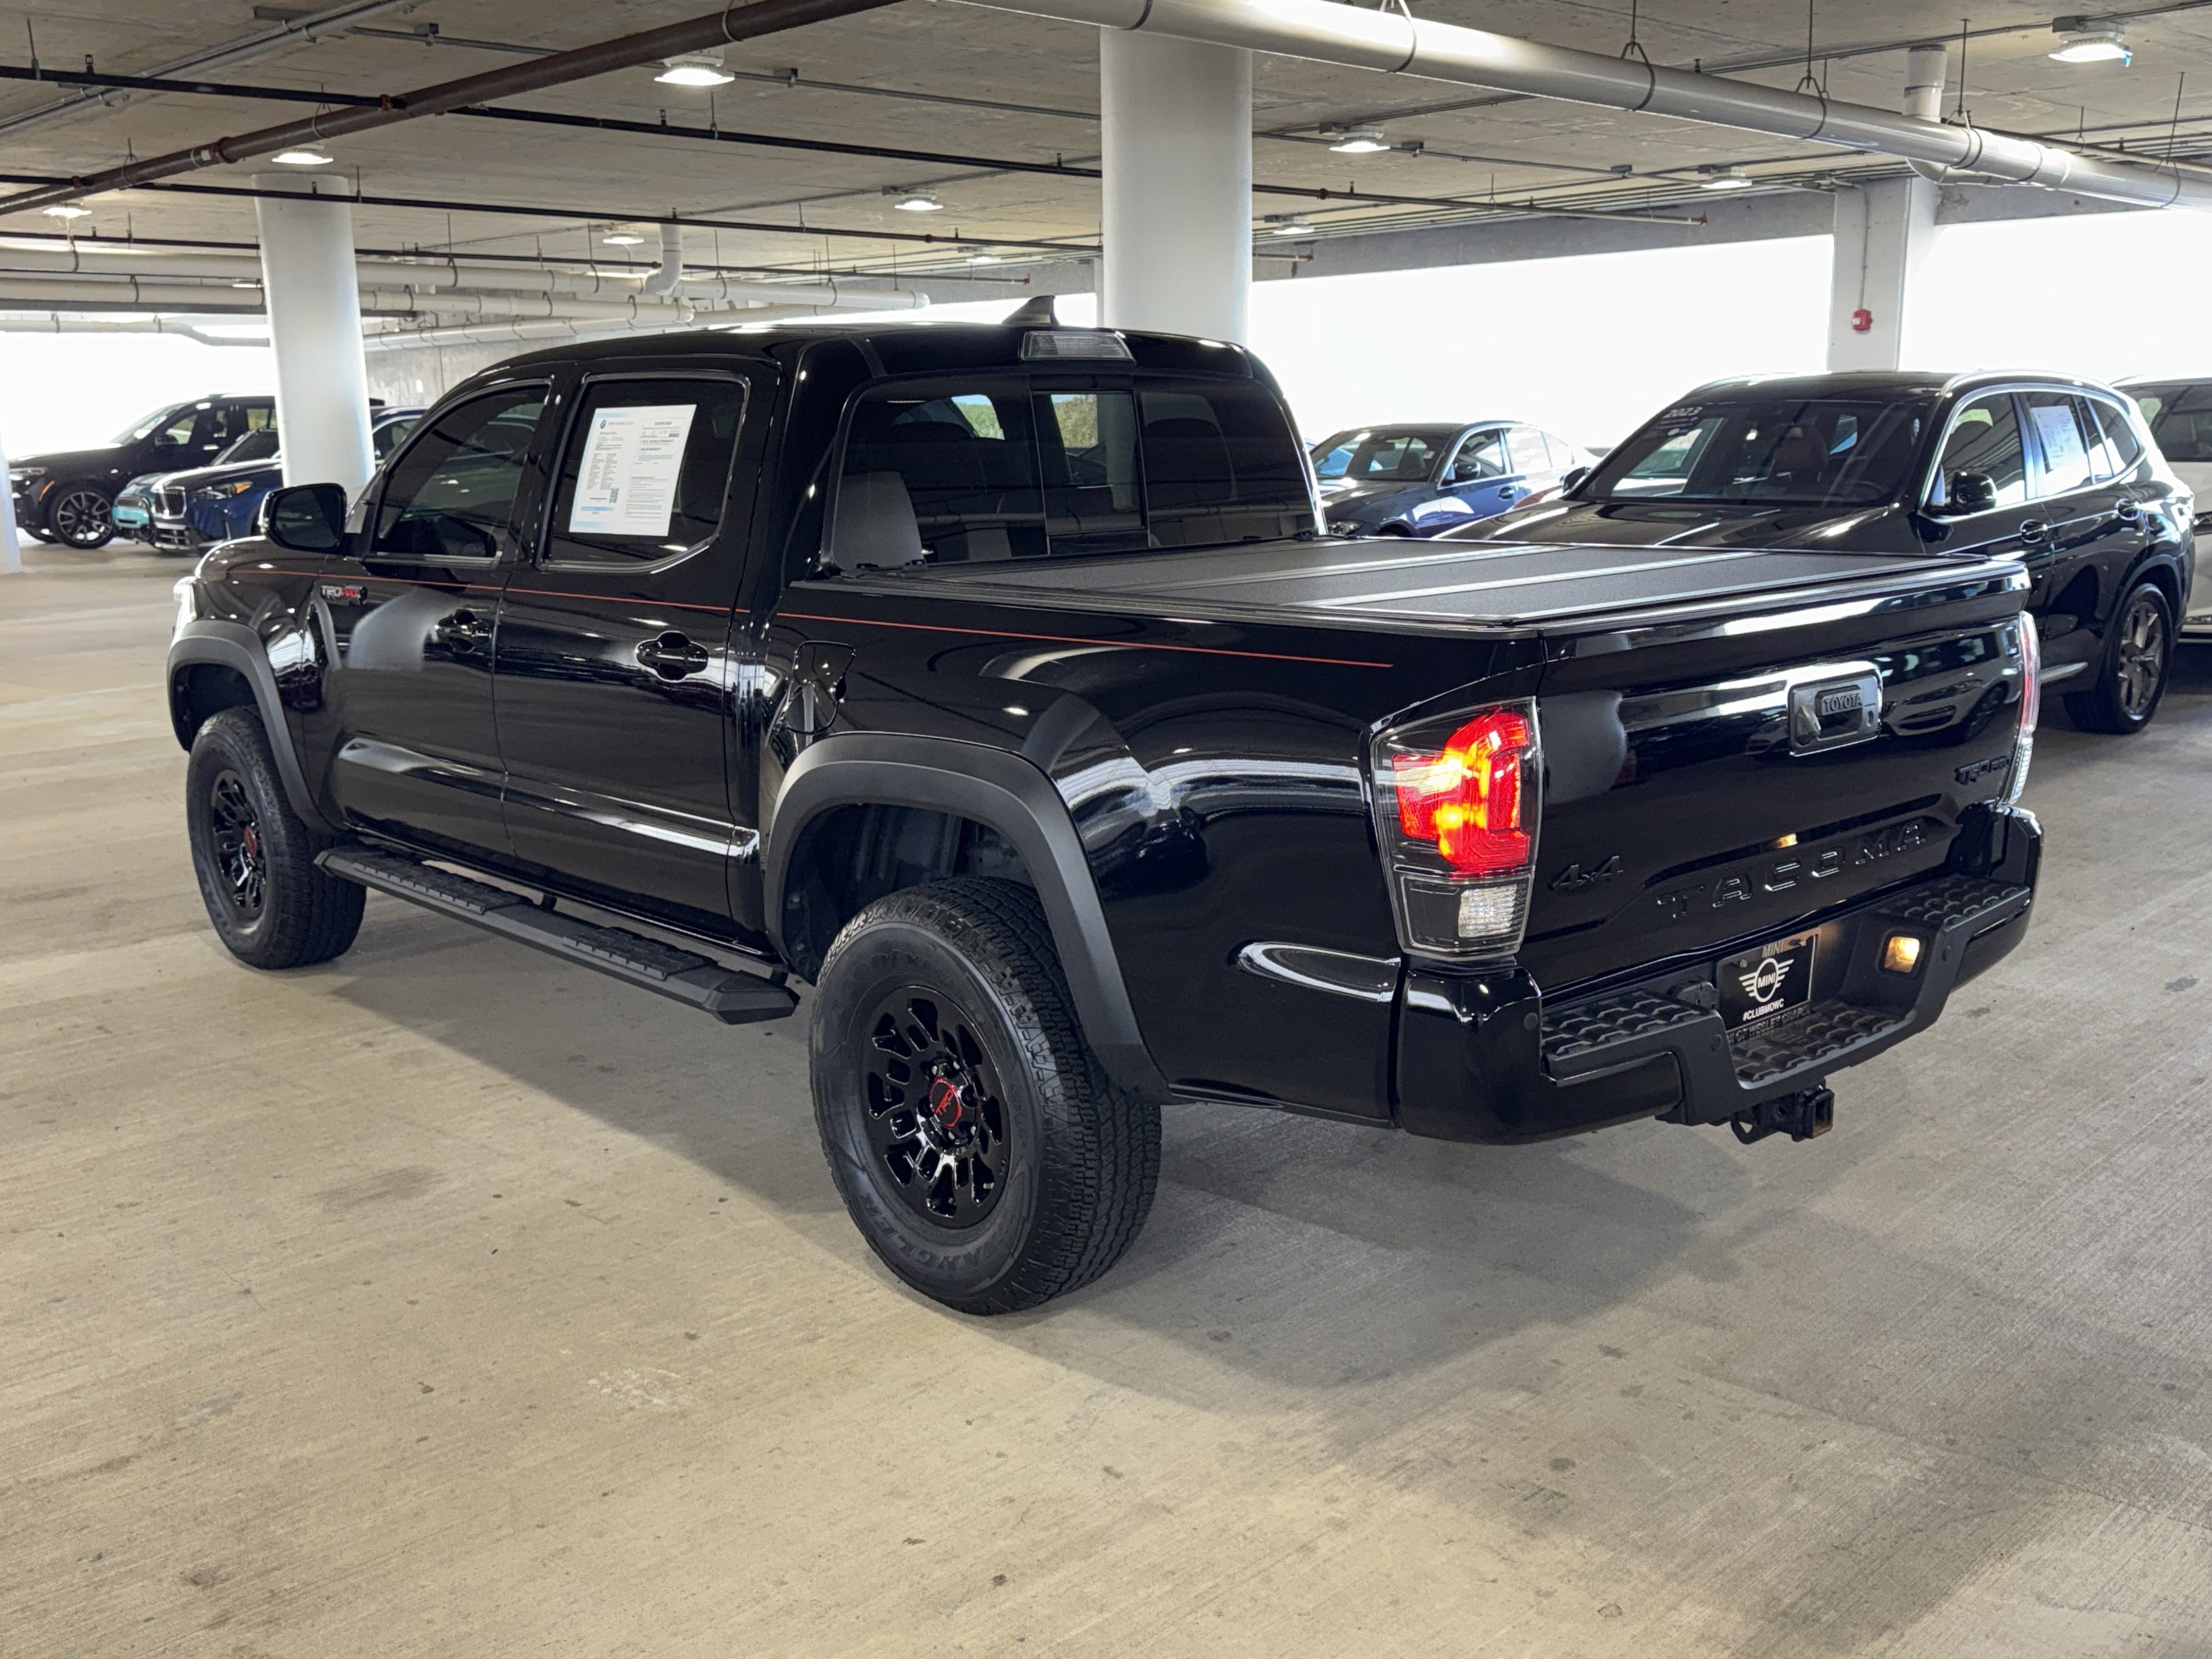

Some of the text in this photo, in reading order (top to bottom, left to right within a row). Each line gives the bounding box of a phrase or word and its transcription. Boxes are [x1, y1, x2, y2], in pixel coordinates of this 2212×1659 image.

[1823, 693, 1863, 713] TOYOTA
[1656, 822, 1926, 919] TACOMA
[1762, 939, 1784, 958] MINI
[1757, 972, 1776, 988] MINI
[1742, 998, 1784, 1022] #CLUBMOWC
[935, 1088, 954, 1115] TRD
